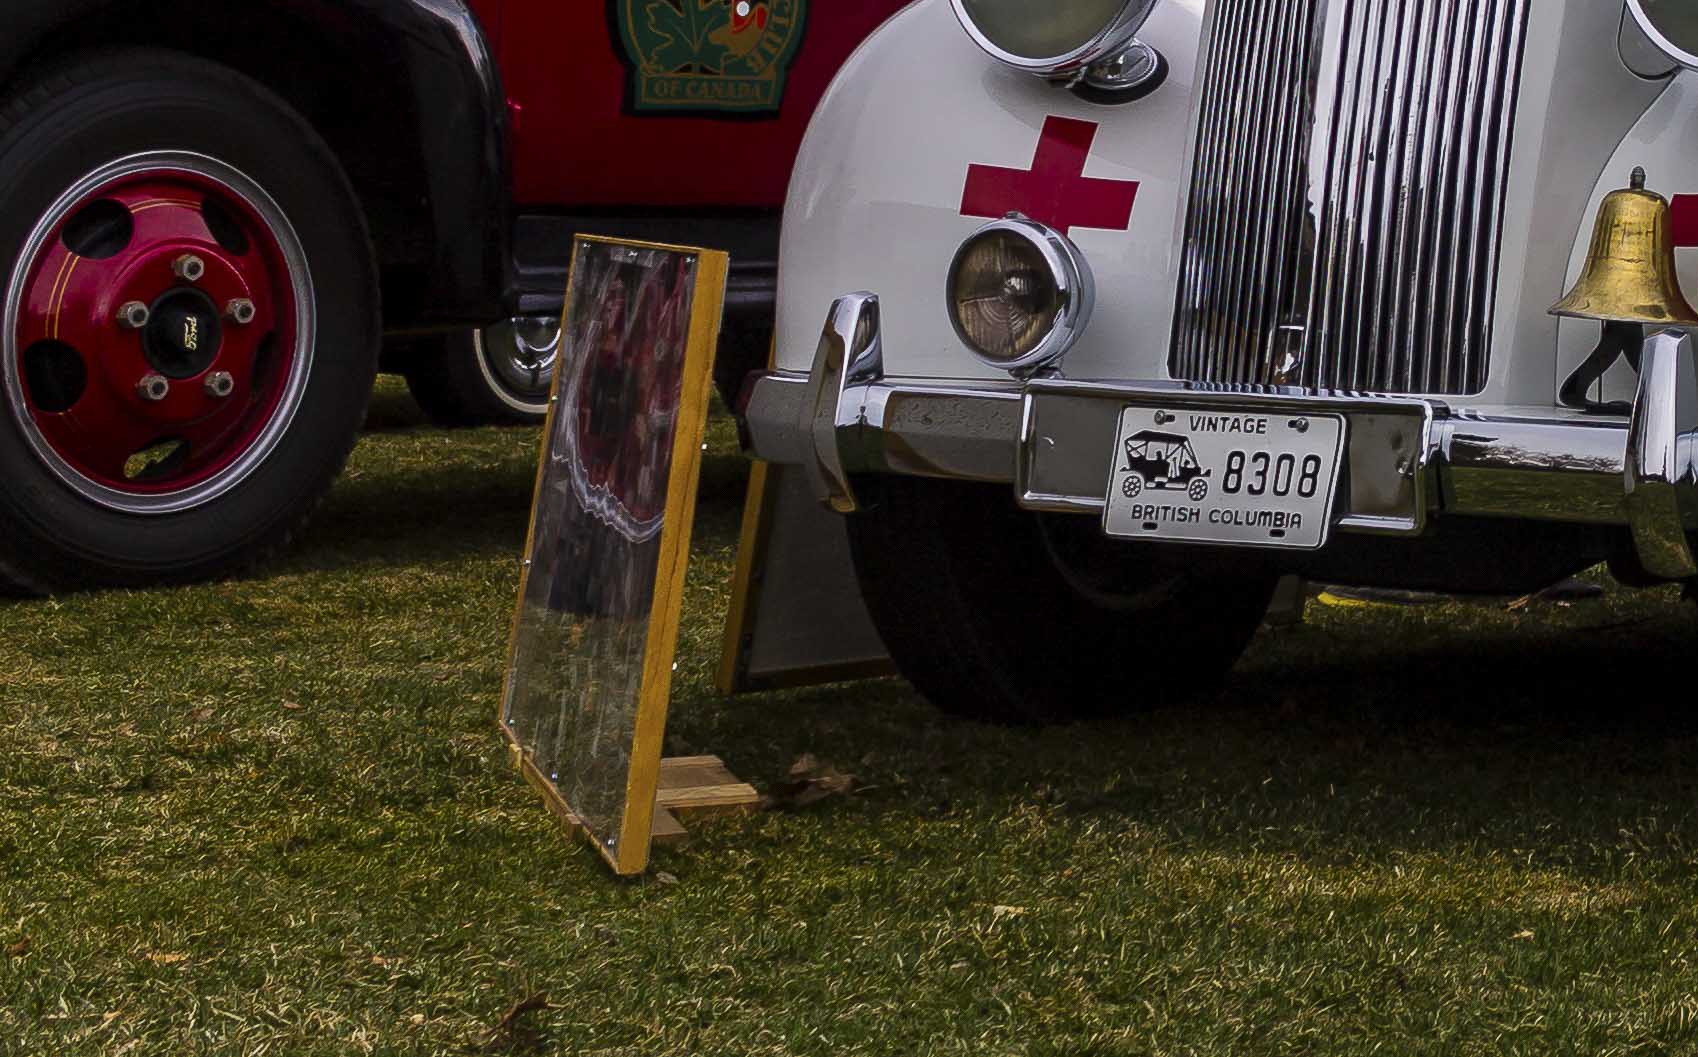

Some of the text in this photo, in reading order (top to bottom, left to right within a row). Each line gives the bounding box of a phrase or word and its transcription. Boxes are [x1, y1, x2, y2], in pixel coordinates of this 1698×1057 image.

[654, 78, 761, 101] OF CANADA
[1189, 415, 1268, 434] VINTAGE
[1222, 450, 1322, 498] 8308
[1131, 504, 1302, 529] BRITISH COLUMBIA
